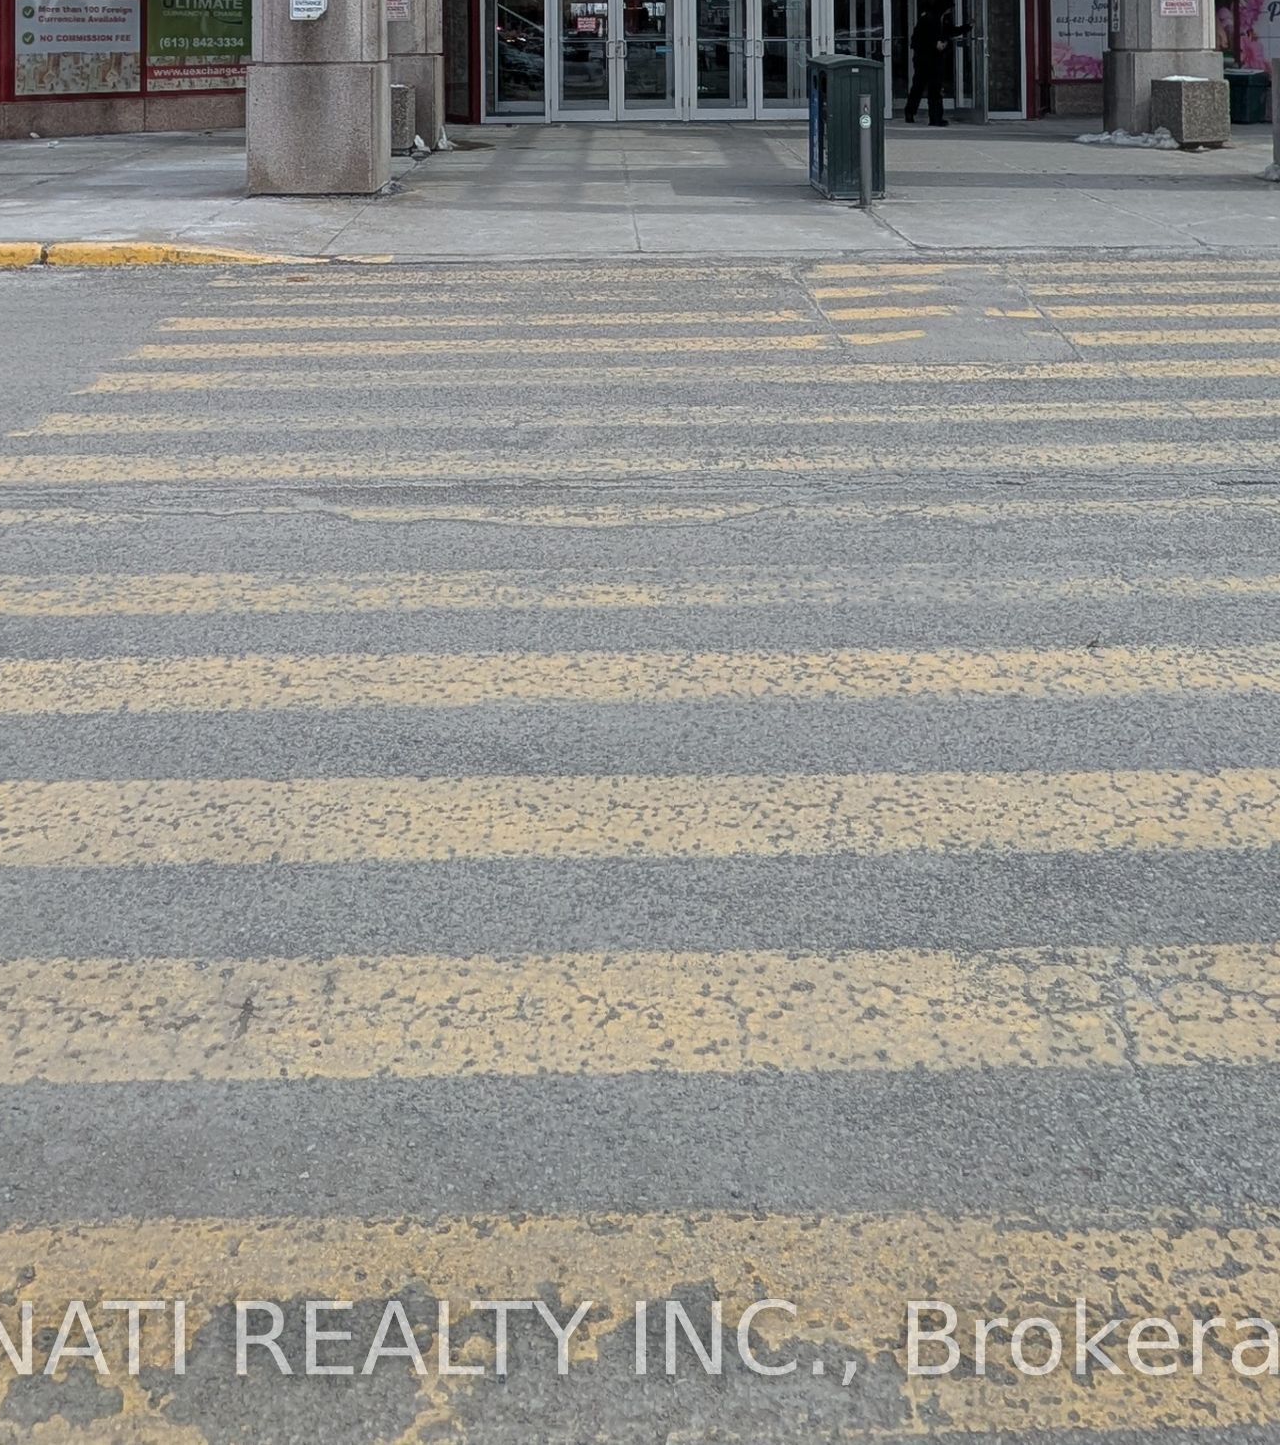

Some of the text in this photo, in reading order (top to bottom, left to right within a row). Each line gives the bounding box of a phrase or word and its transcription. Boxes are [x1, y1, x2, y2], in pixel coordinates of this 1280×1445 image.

[38, 5, 133, 15] More than 100 Foreign
[38, 15, 127, 23] Currencies Available
[40, 34, 132, 42] NO COMMISSION FEE
[160, 37, 244, 50] (613) 842-3334
[153, 66, 248, 77] www.uexchange.c
